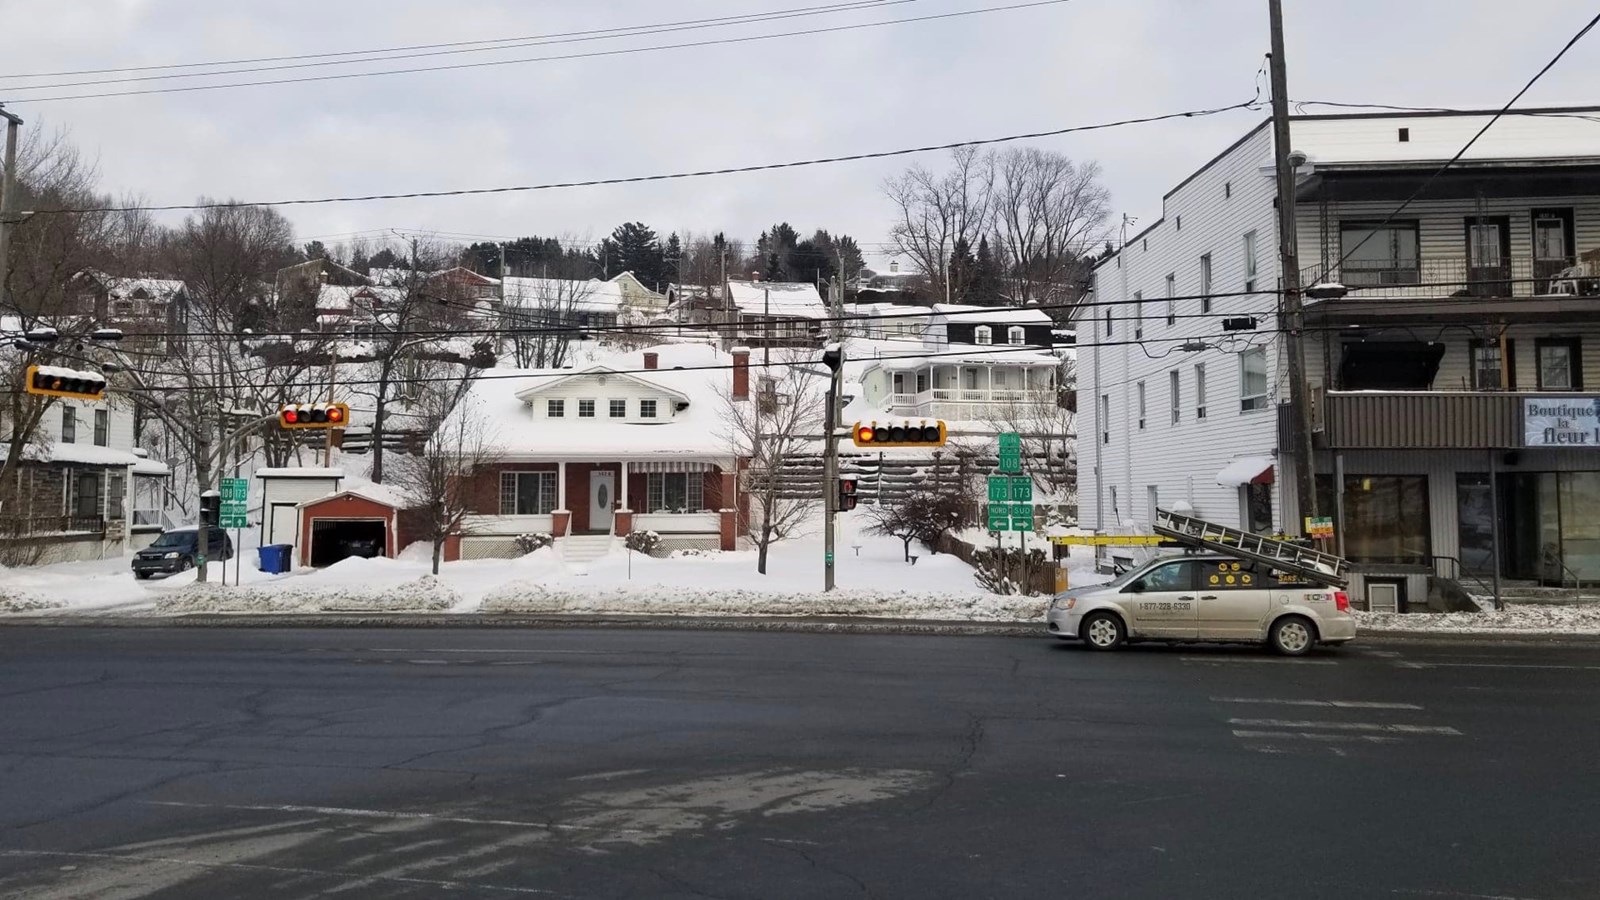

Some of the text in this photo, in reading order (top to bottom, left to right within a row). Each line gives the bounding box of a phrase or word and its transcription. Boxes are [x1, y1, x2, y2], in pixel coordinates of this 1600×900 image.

[1529, 404, 1594, 420] Boutique
[1557, 418, 1569, 428] la
[1543, 427, 1589, 445] fleur
[1002, 458, 1018, 468] 108
[222, 488, 233, 498] 108
[235, 488, 246, 499] 173
[991, 487, 1007, 498] 173
[1013, 487, 1031, 498] 173
